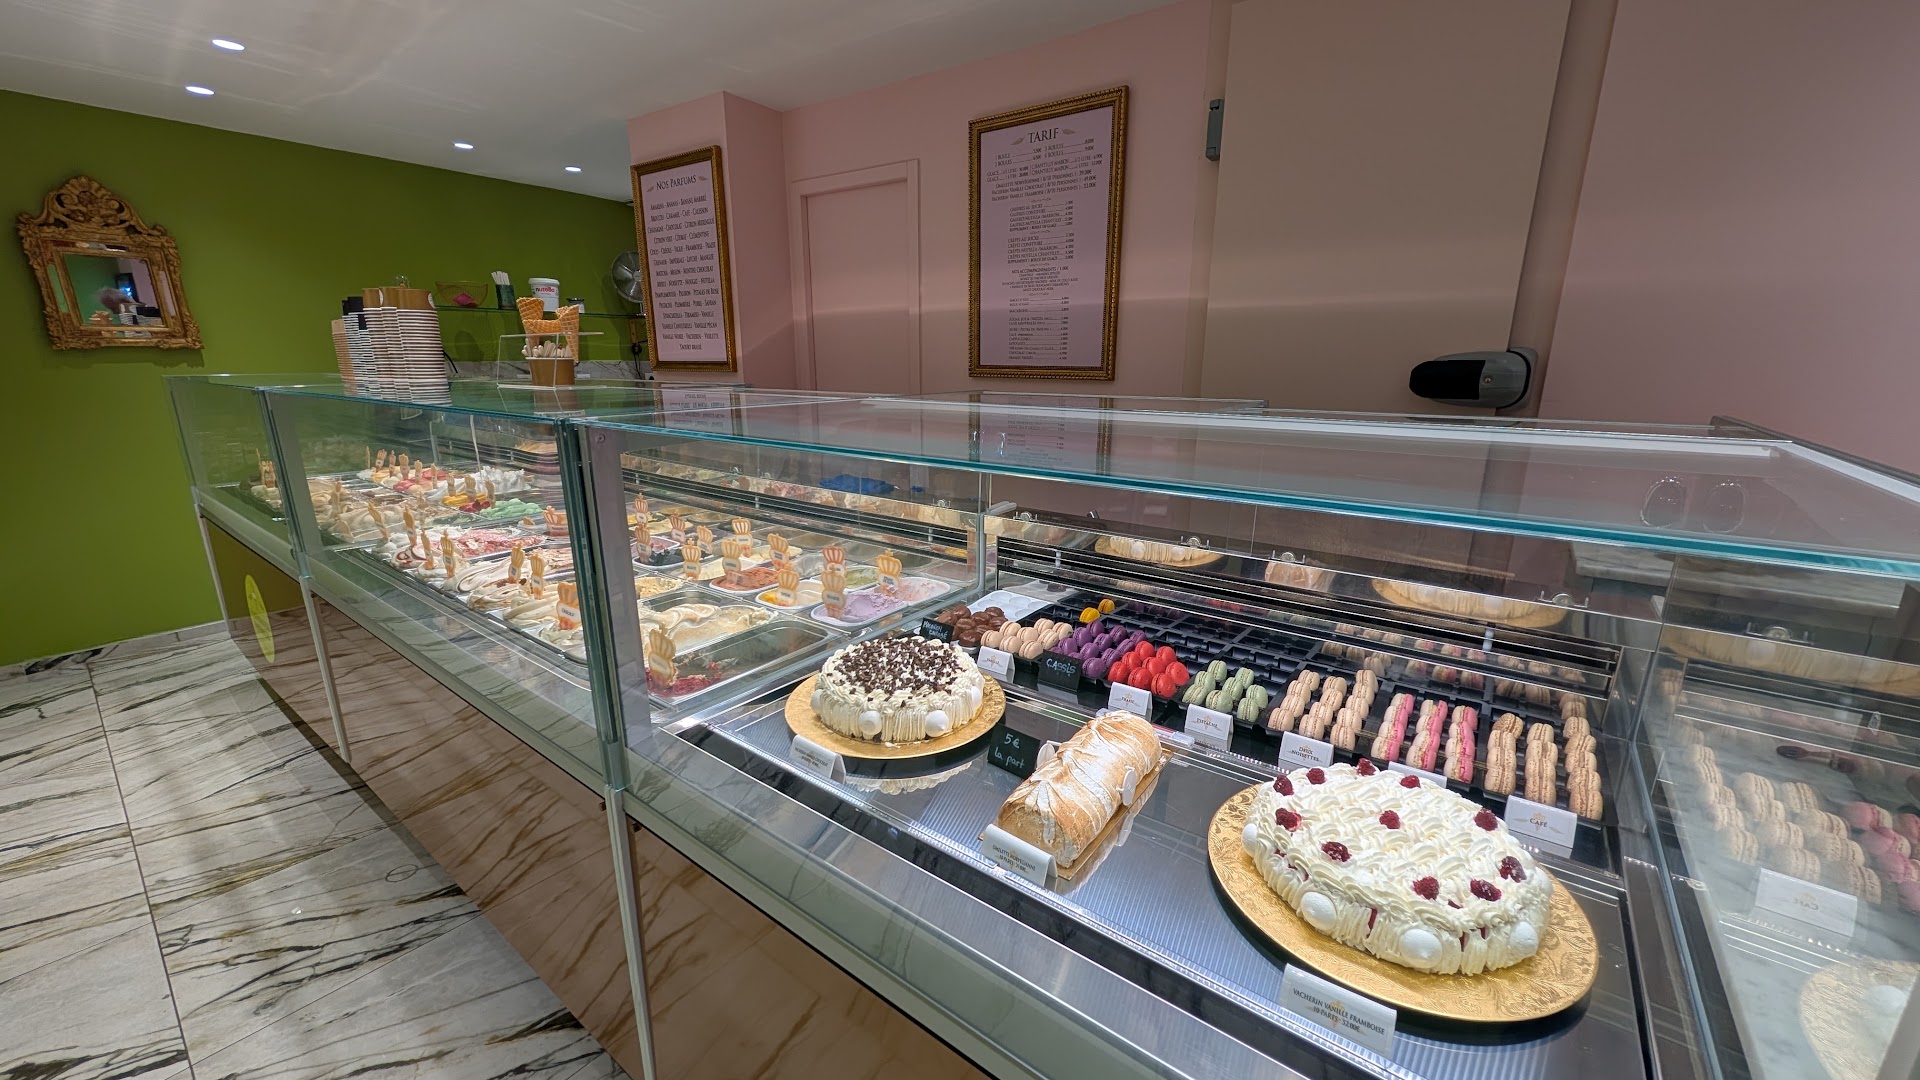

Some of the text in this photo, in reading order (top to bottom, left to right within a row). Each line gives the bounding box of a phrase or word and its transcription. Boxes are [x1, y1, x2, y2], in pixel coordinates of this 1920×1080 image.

[1028, 127, 1059, 144] TARIF
[656, 174, 697, 191] NOS PARFUMS
[1004, 733, 1020, 749] 5€
[994, 746, 1025, 769] la part
[1529, 817, 1548, 828] CAFÉ
[1293, 988, 1385, 1035] VACHERIN VANILLE FRAMBOISE
[1320, 1009, 1338, 1022] PARTS
